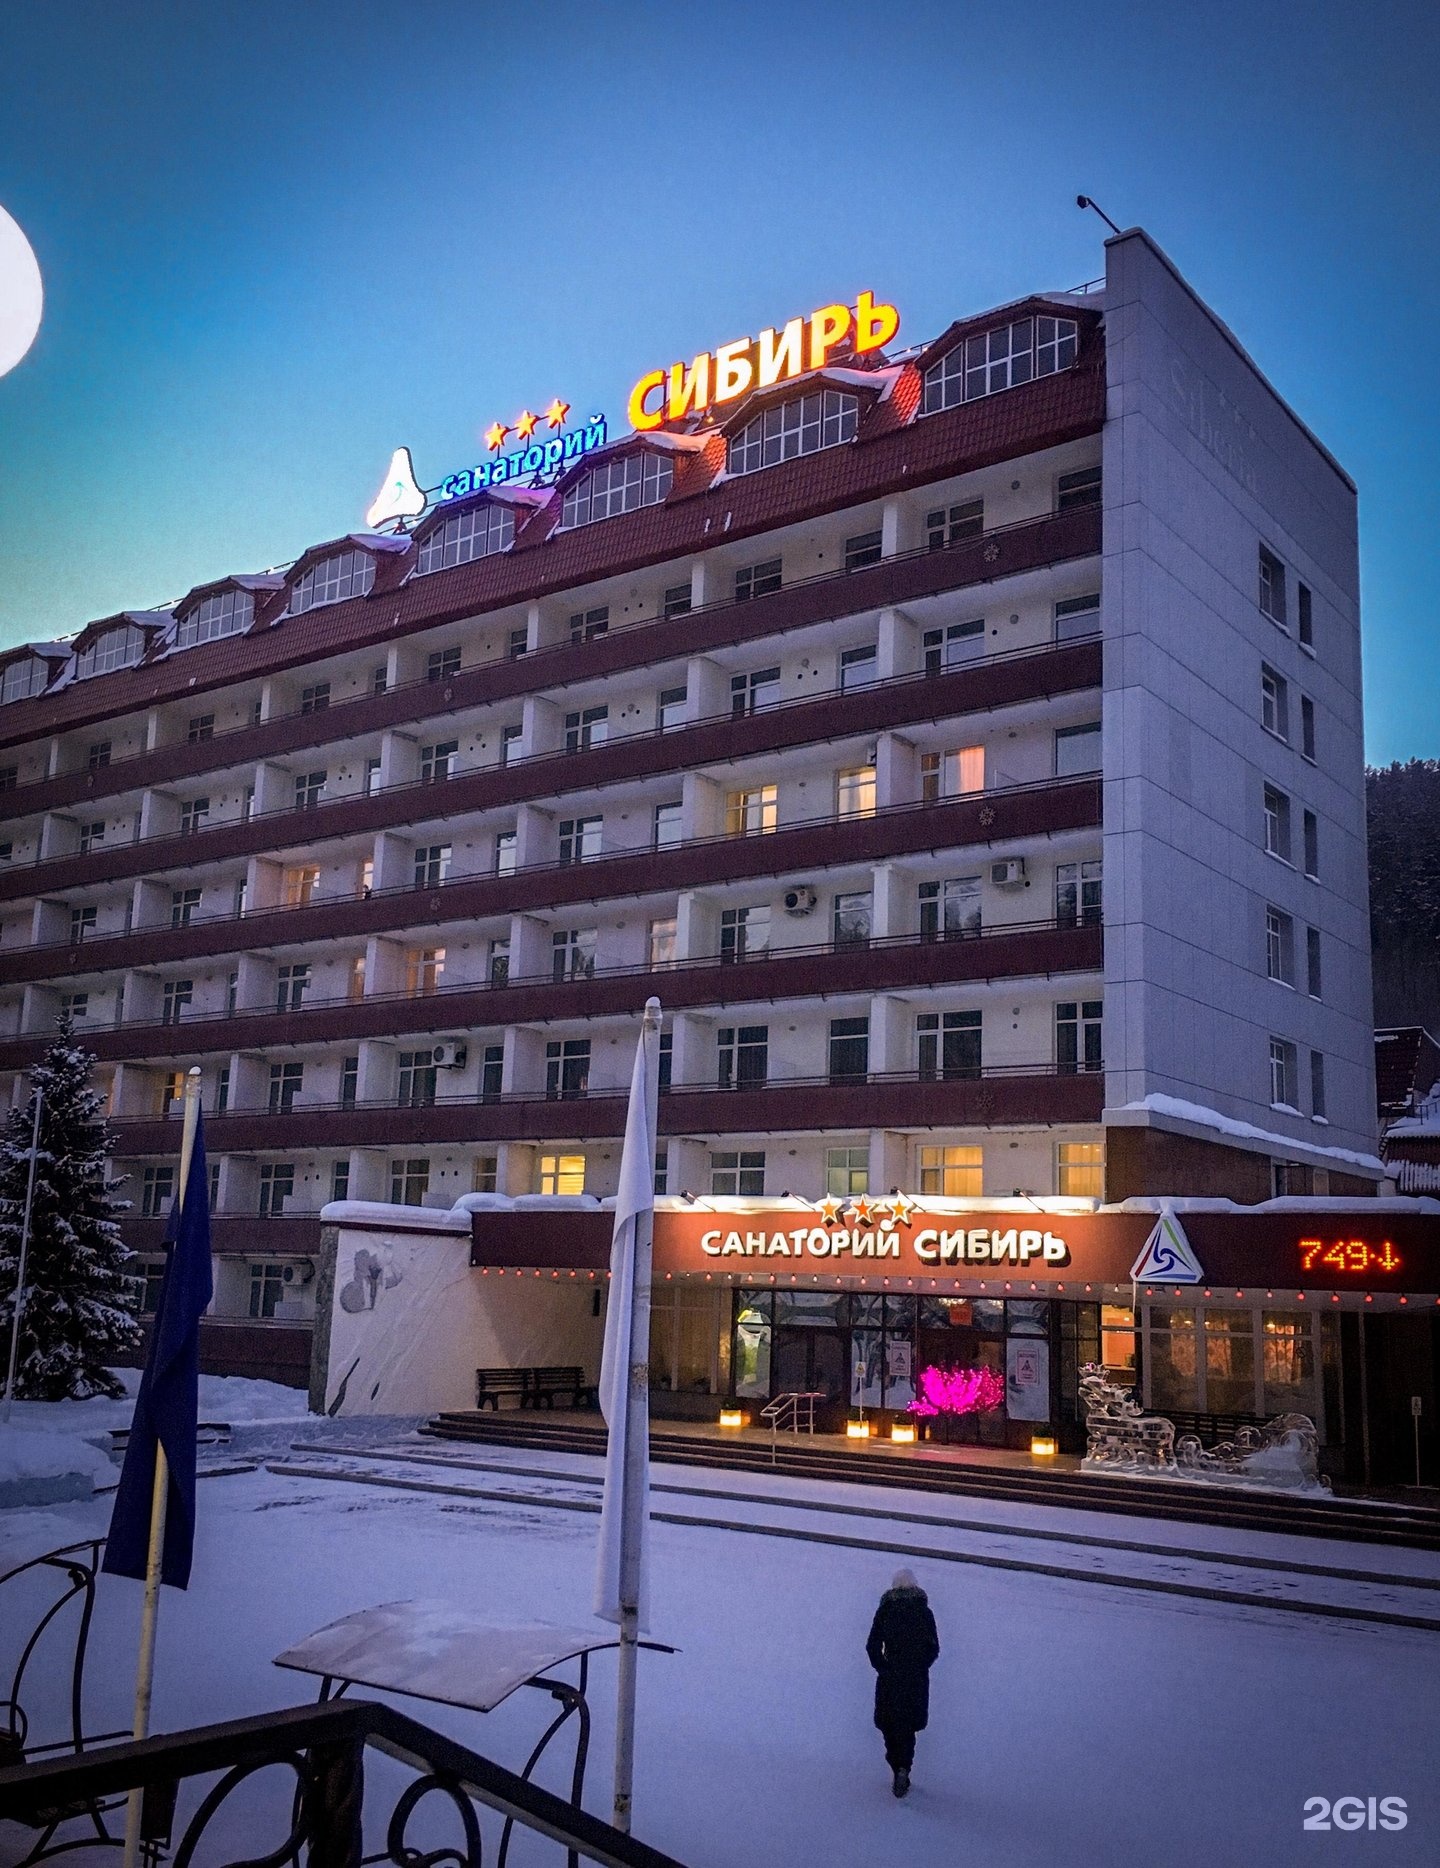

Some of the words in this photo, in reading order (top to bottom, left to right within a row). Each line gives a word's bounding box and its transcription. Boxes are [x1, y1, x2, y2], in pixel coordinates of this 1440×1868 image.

[440, 413, 608, 501] санаторий
[627, 289, 900, 432] СИБИРЬ
[701, 1219, 900, 1258] САНАТОРИЙ
[914, 1228, 1070, 1265] СИБИРЬ
